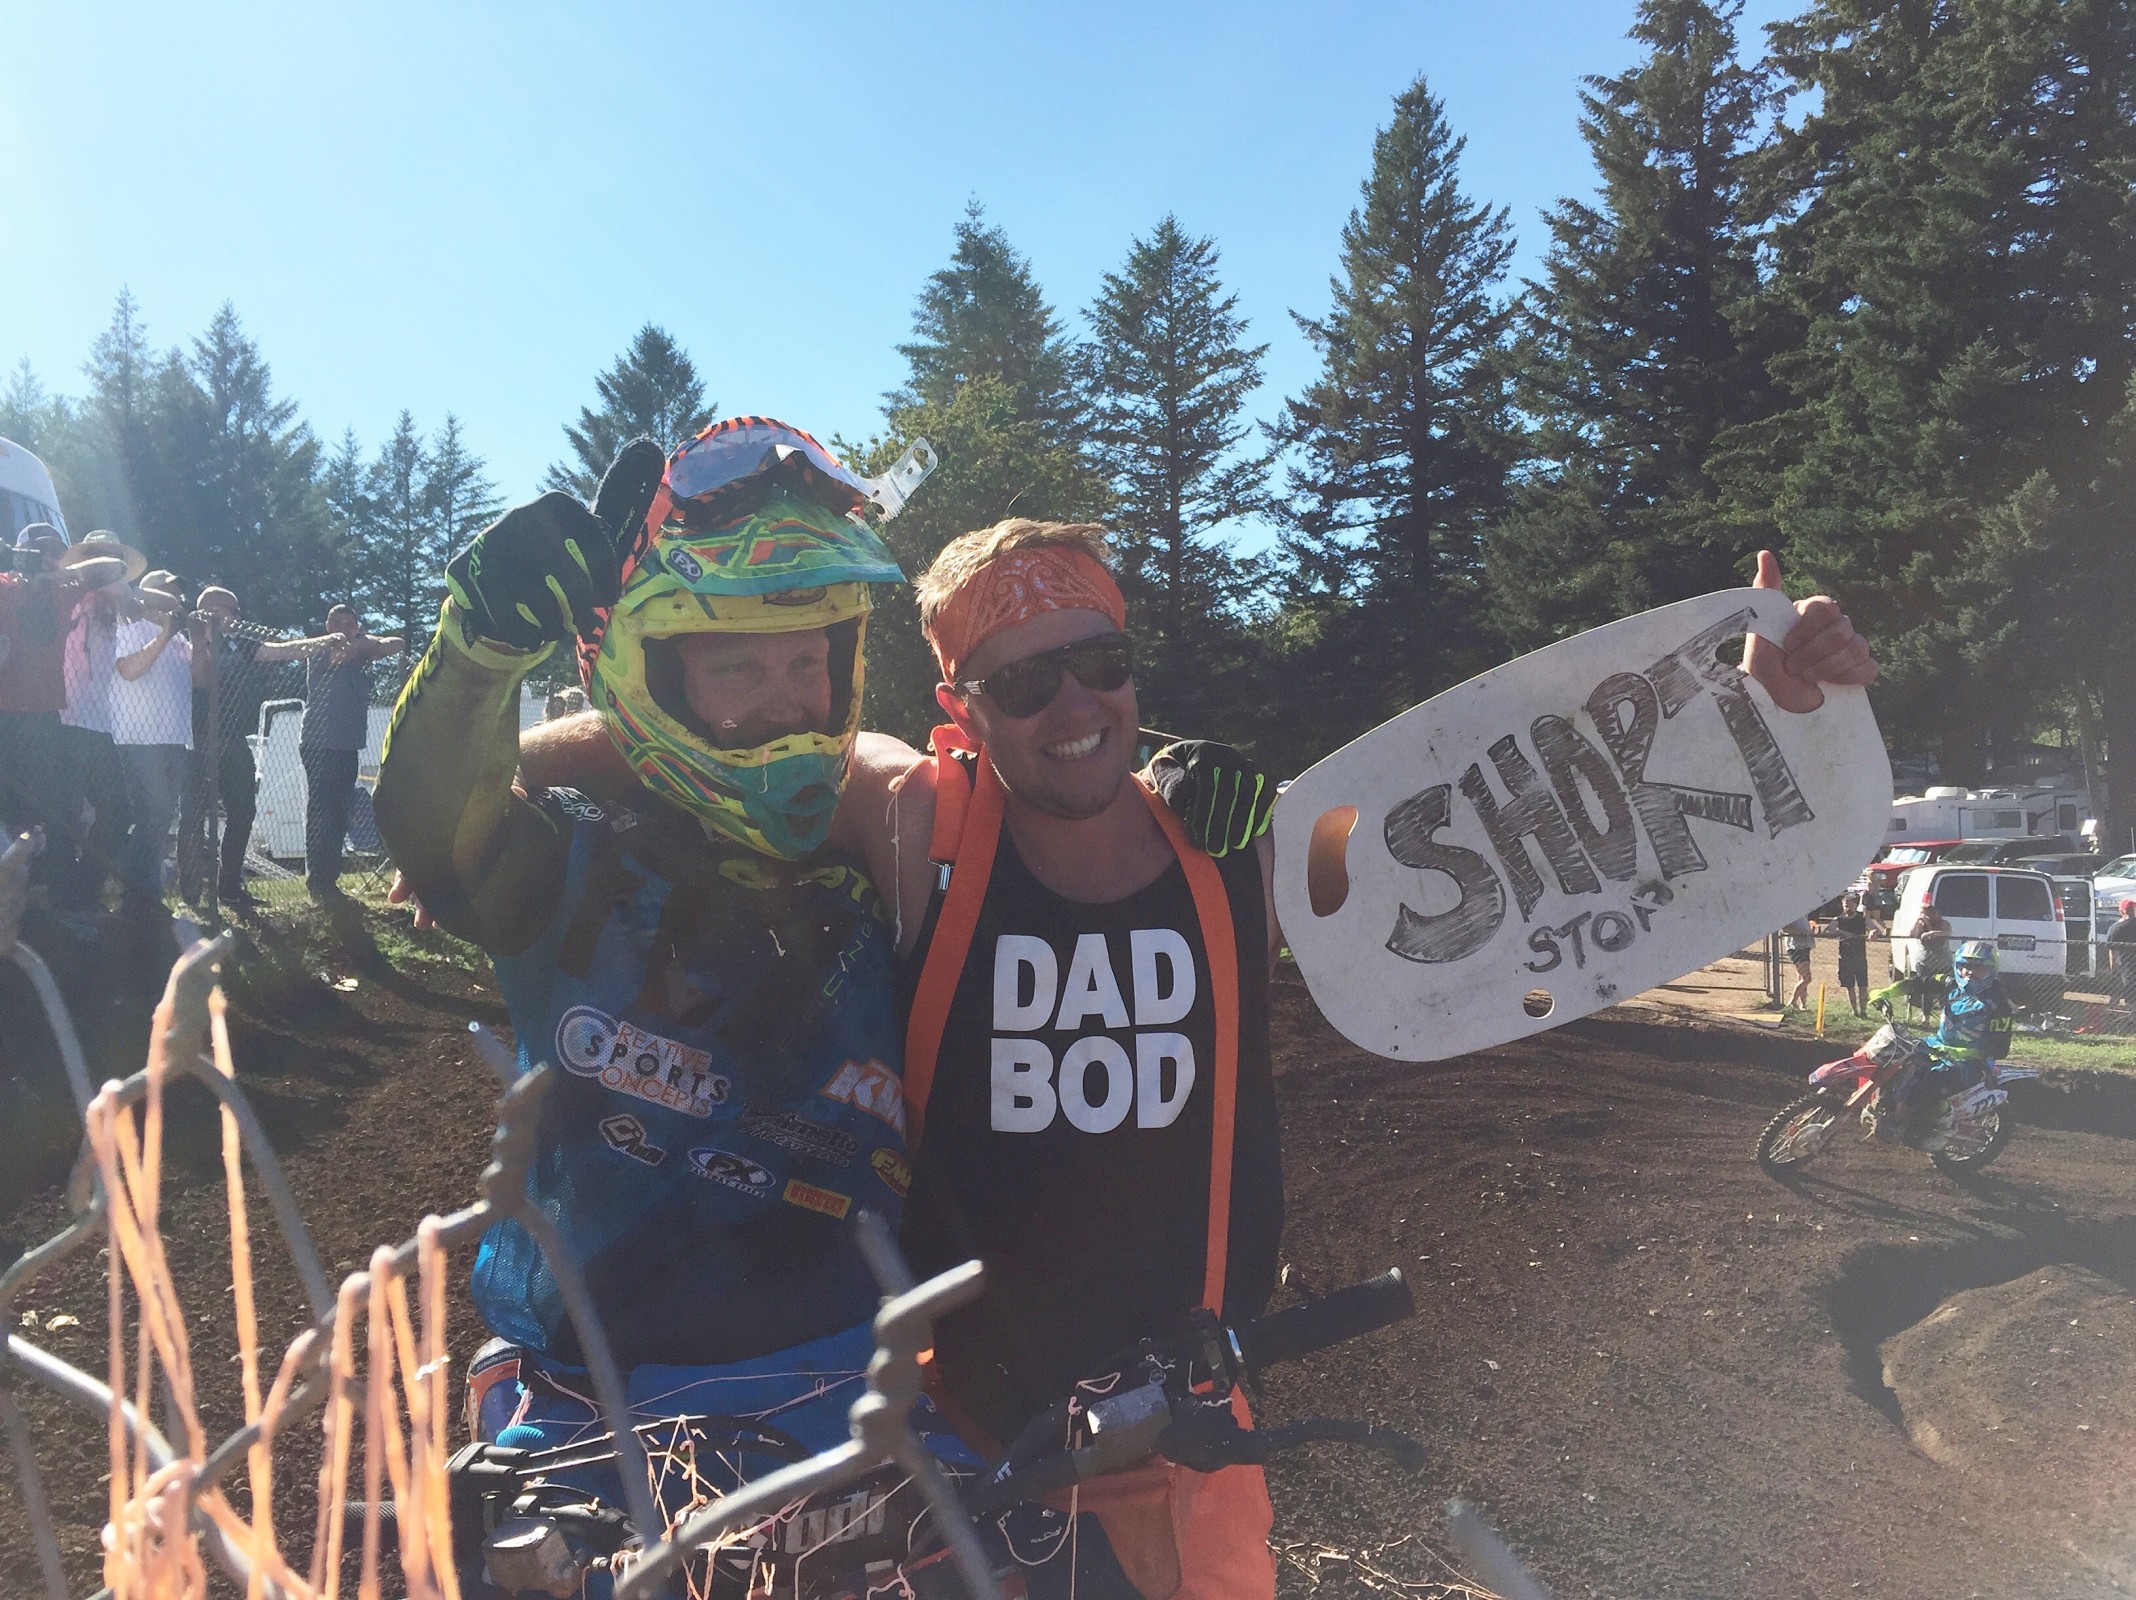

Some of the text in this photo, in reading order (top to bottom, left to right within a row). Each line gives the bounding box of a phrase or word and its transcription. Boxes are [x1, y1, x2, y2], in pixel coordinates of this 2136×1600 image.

[1383, 606, 1815, 966] SHORT
[1524, 884, 1674, 973] STOP
[993, 928, 1196, 1031] DAD
[1989, 1017, 2012, 1033] FLY
[585, 1034, 728, 1101] SPORTS
[991, 1032, 1196, 1134] BOD
